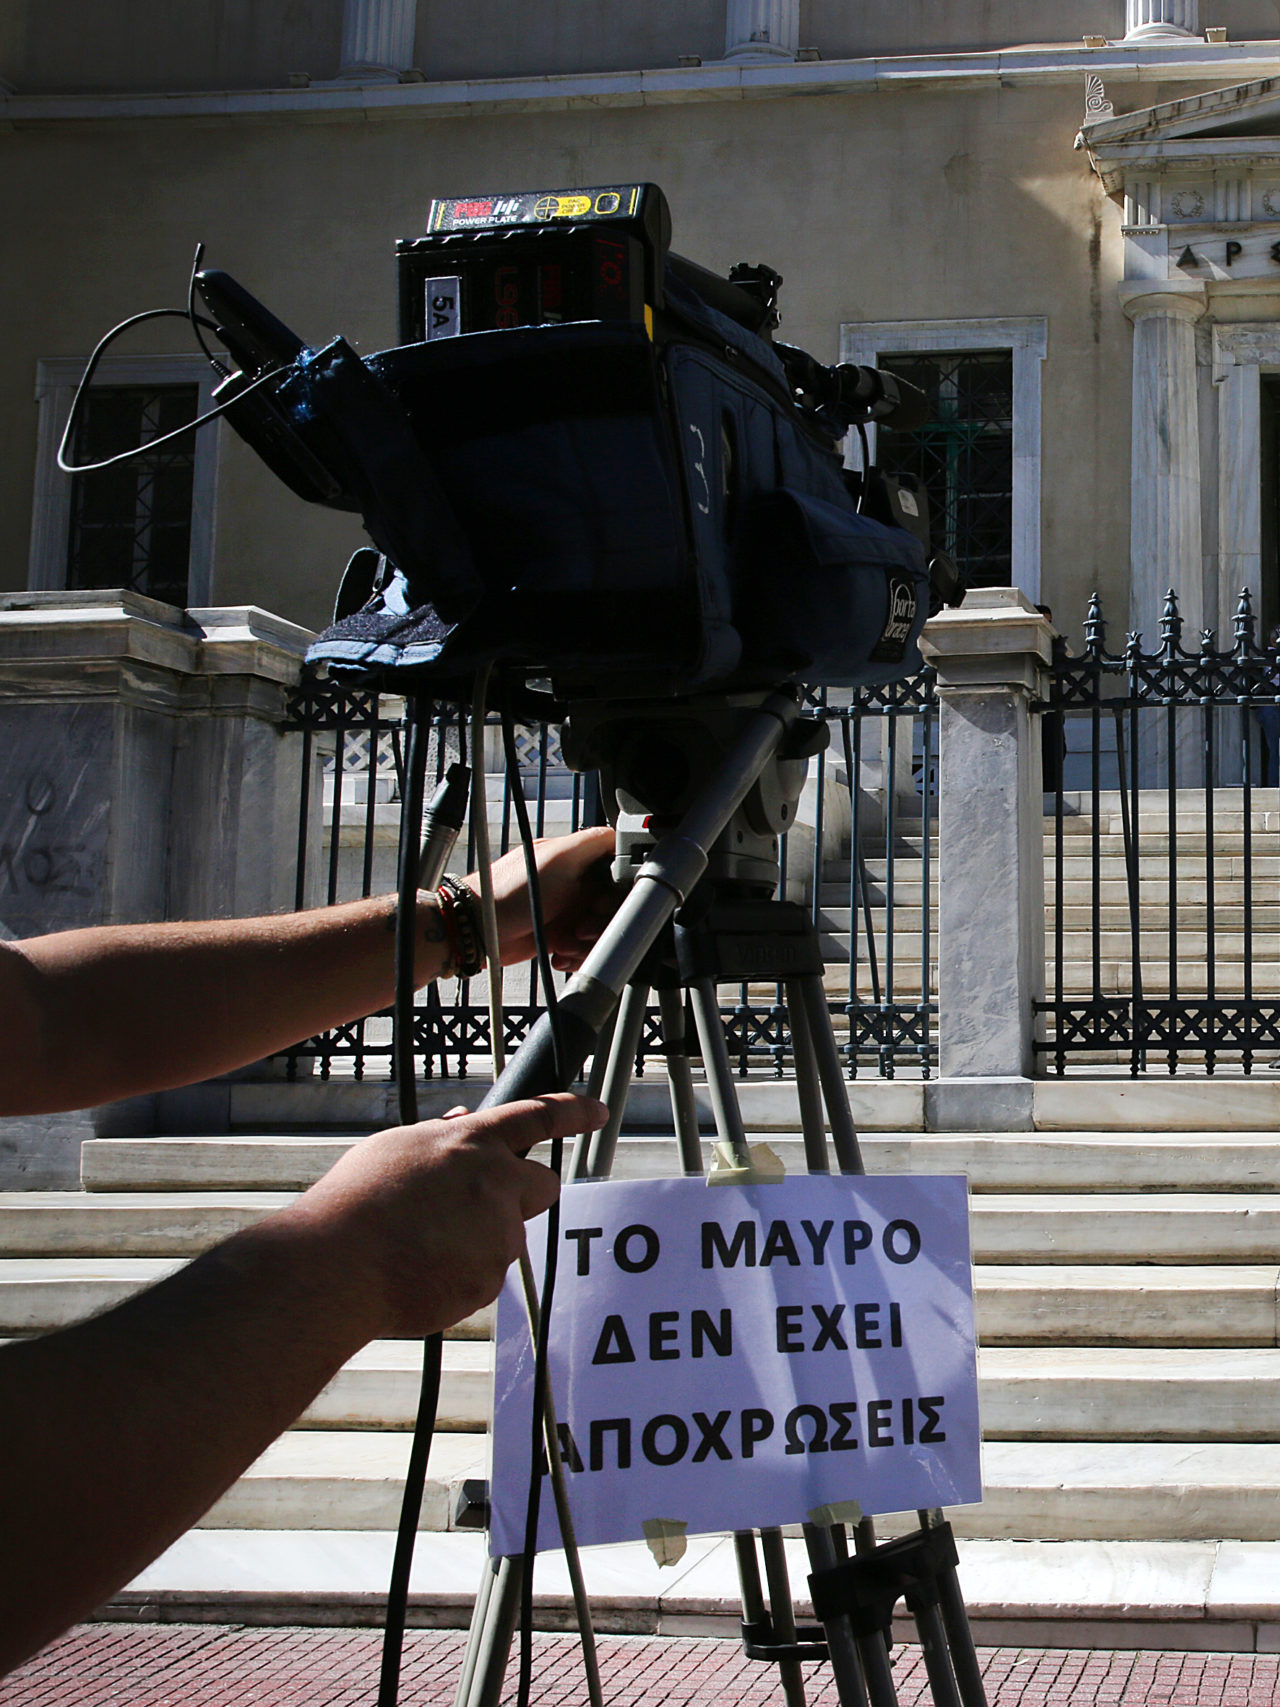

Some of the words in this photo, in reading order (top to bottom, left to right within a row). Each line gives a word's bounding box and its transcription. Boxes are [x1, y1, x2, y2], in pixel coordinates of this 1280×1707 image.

[453, 217, 486, 226] POWER
[488, 216, 517, 224] PLATE
[432, 296, 455, 329] 5A
[565, 1224, 660, 1276] ΤΟ
[701, 1219, 921, 1269] ΜΑΥΡΟ
[591, 1308, 732, 1365] ΔΕΝ
[777, 1302, 903, 1354] ΕΧΕΙ
